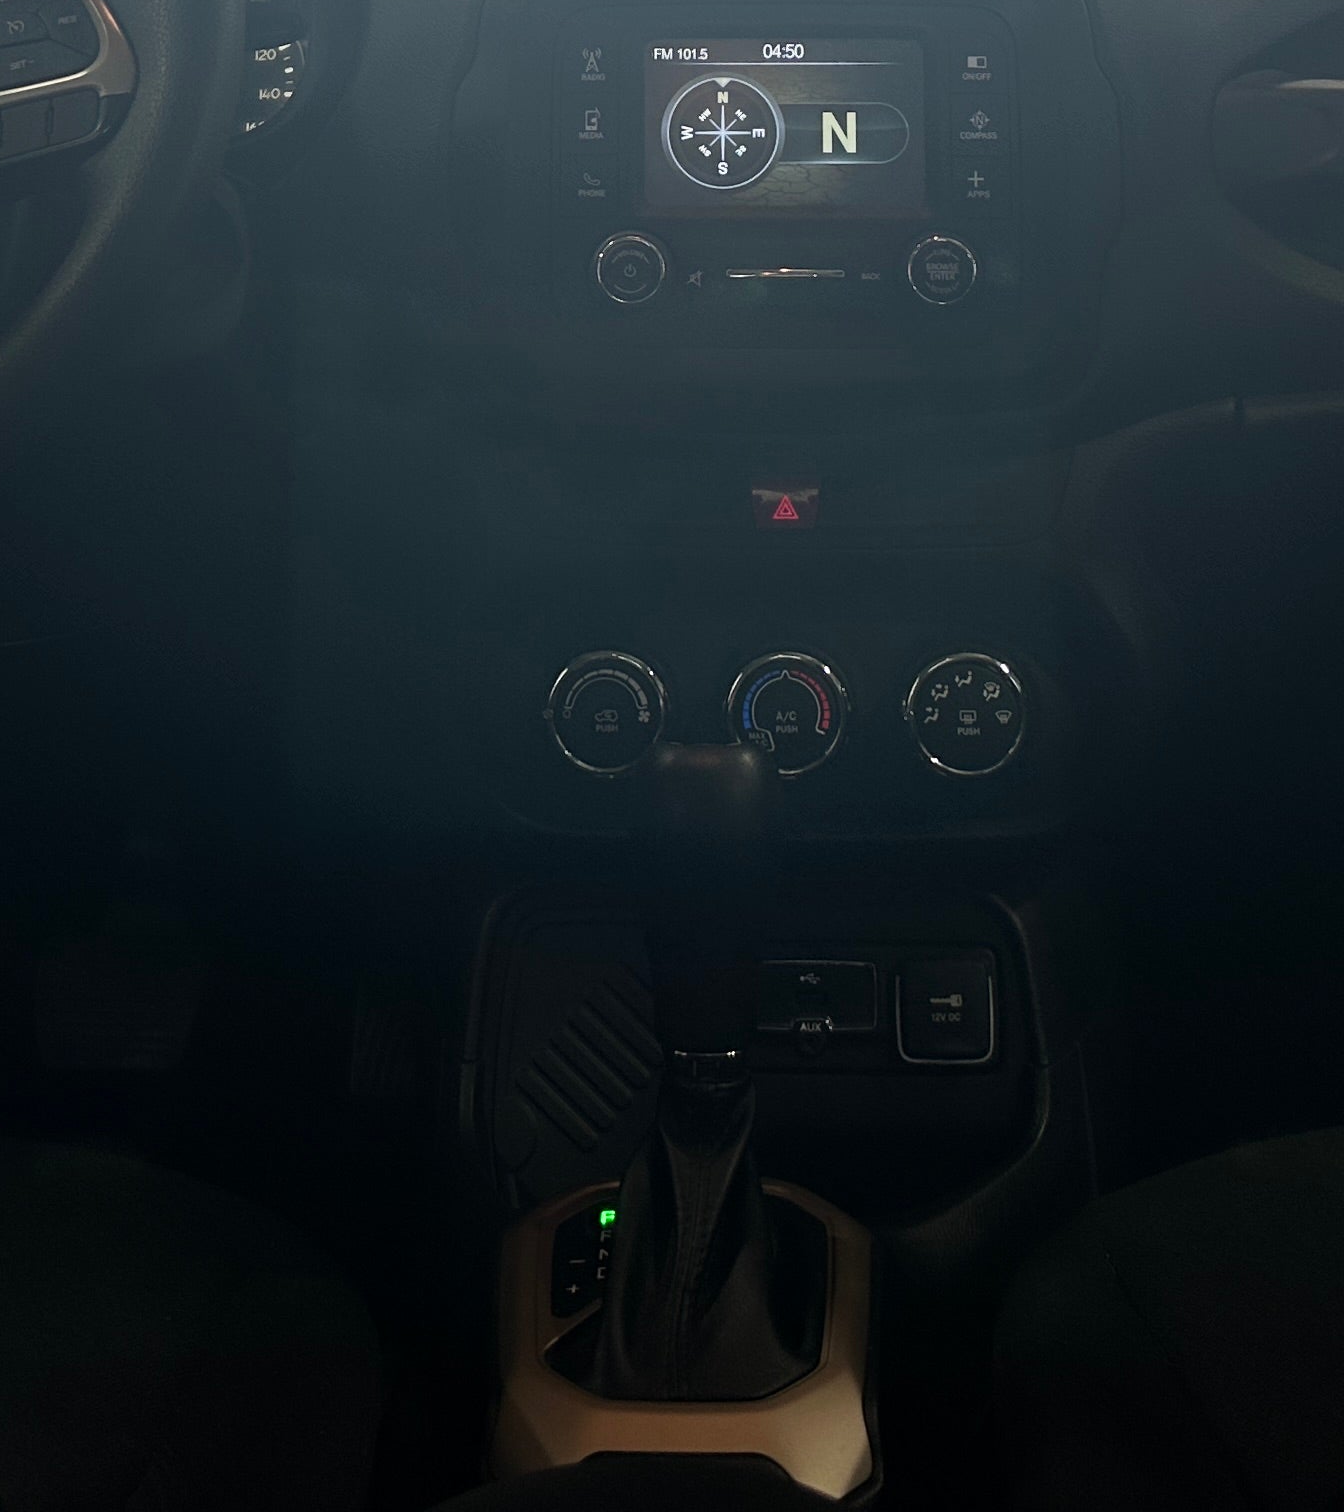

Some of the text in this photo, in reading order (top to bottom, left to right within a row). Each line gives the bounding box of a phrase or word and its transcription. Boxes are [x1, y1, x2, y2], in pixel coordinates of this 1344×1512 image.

[255, 48, 277, 61] 120
[653, 48, 708, 61] FM 101.5
[762, 43, 805, 60] 04:50
[259, 88, 281, 100] 140
[717, 91, 729, 104] N
[680, 125, 694, 141] W
[752, 128, 766, 139] E
[822, 111, 856, 154] N
[960, 131, 997, 140] COMPASS
[717, 161, 729, 175] S
[776, 711, 798, 722] A/C
[957, 727, 981, 736] PUSH
[799, 1022, 822, 1033] AUX
